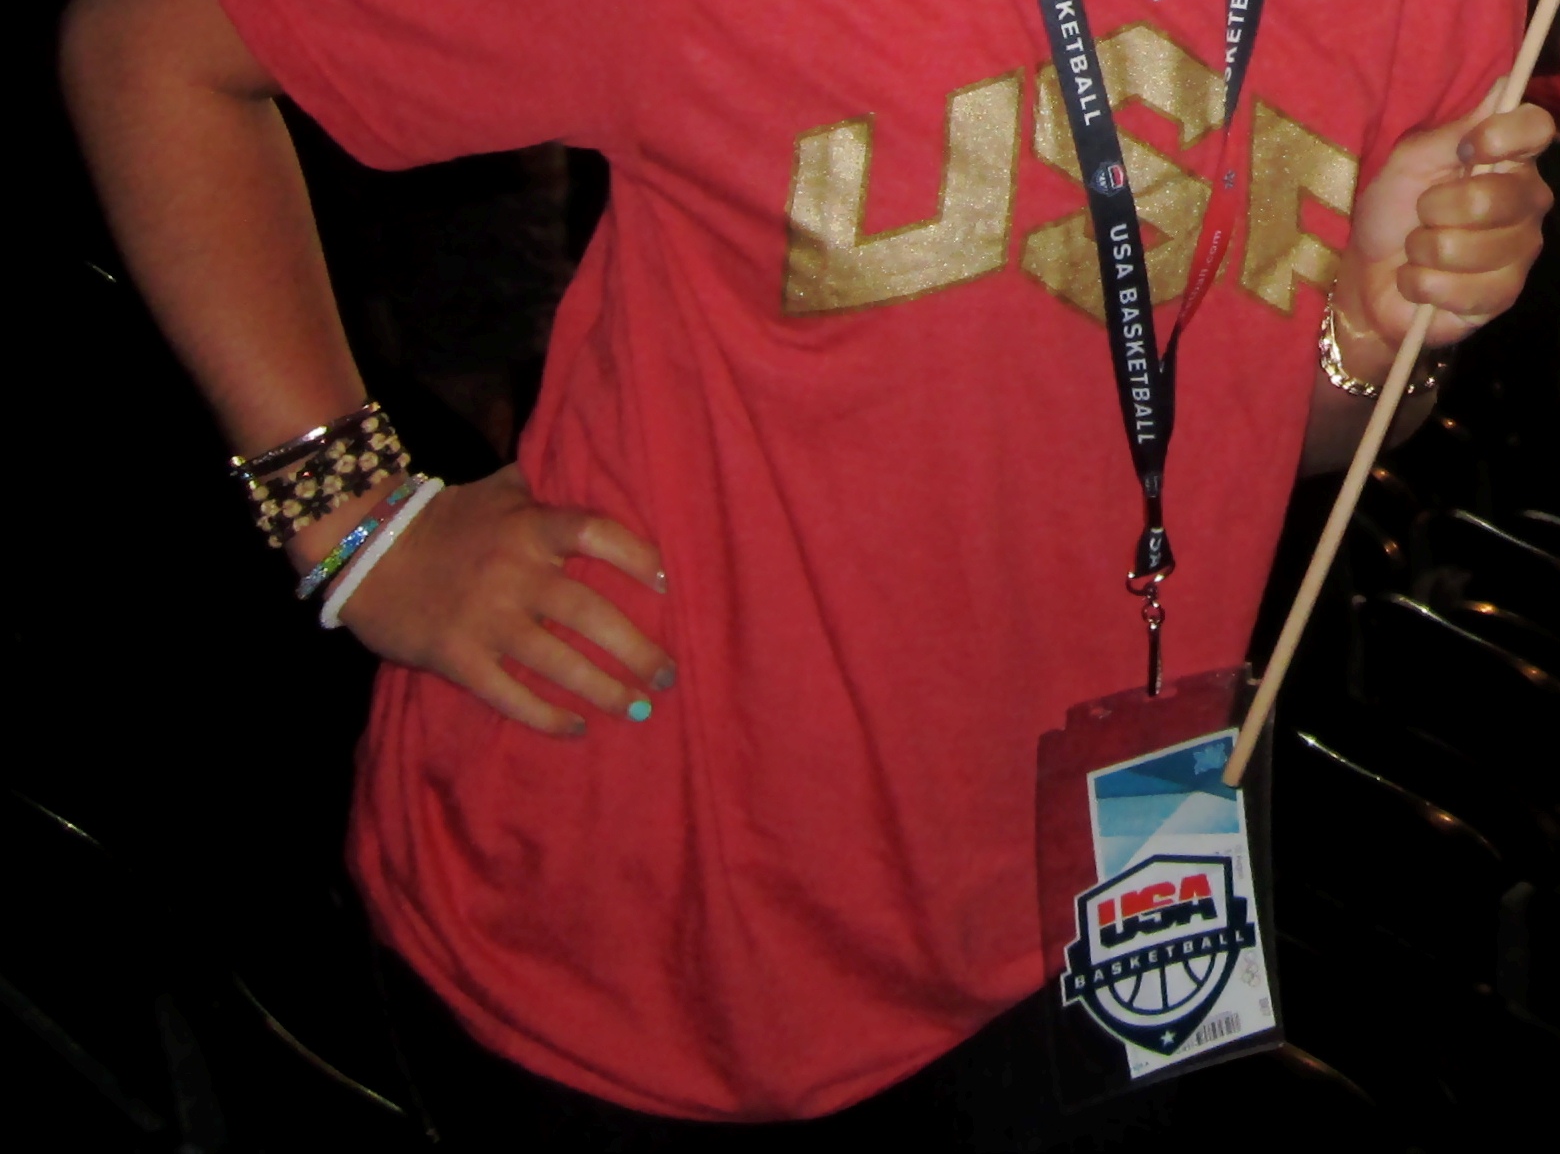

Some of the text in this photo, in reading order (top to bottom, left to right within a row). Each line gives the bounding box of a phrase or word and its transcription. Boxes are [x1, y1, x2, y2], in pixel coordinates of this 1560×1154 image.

[1109, 222, 1135, 280] USA
[1118, 286, 1157, 445] BASKETBALL
[1096, 872, 1218, 949] USA
[1073, 928, 1246, 991] BASKETBALL
